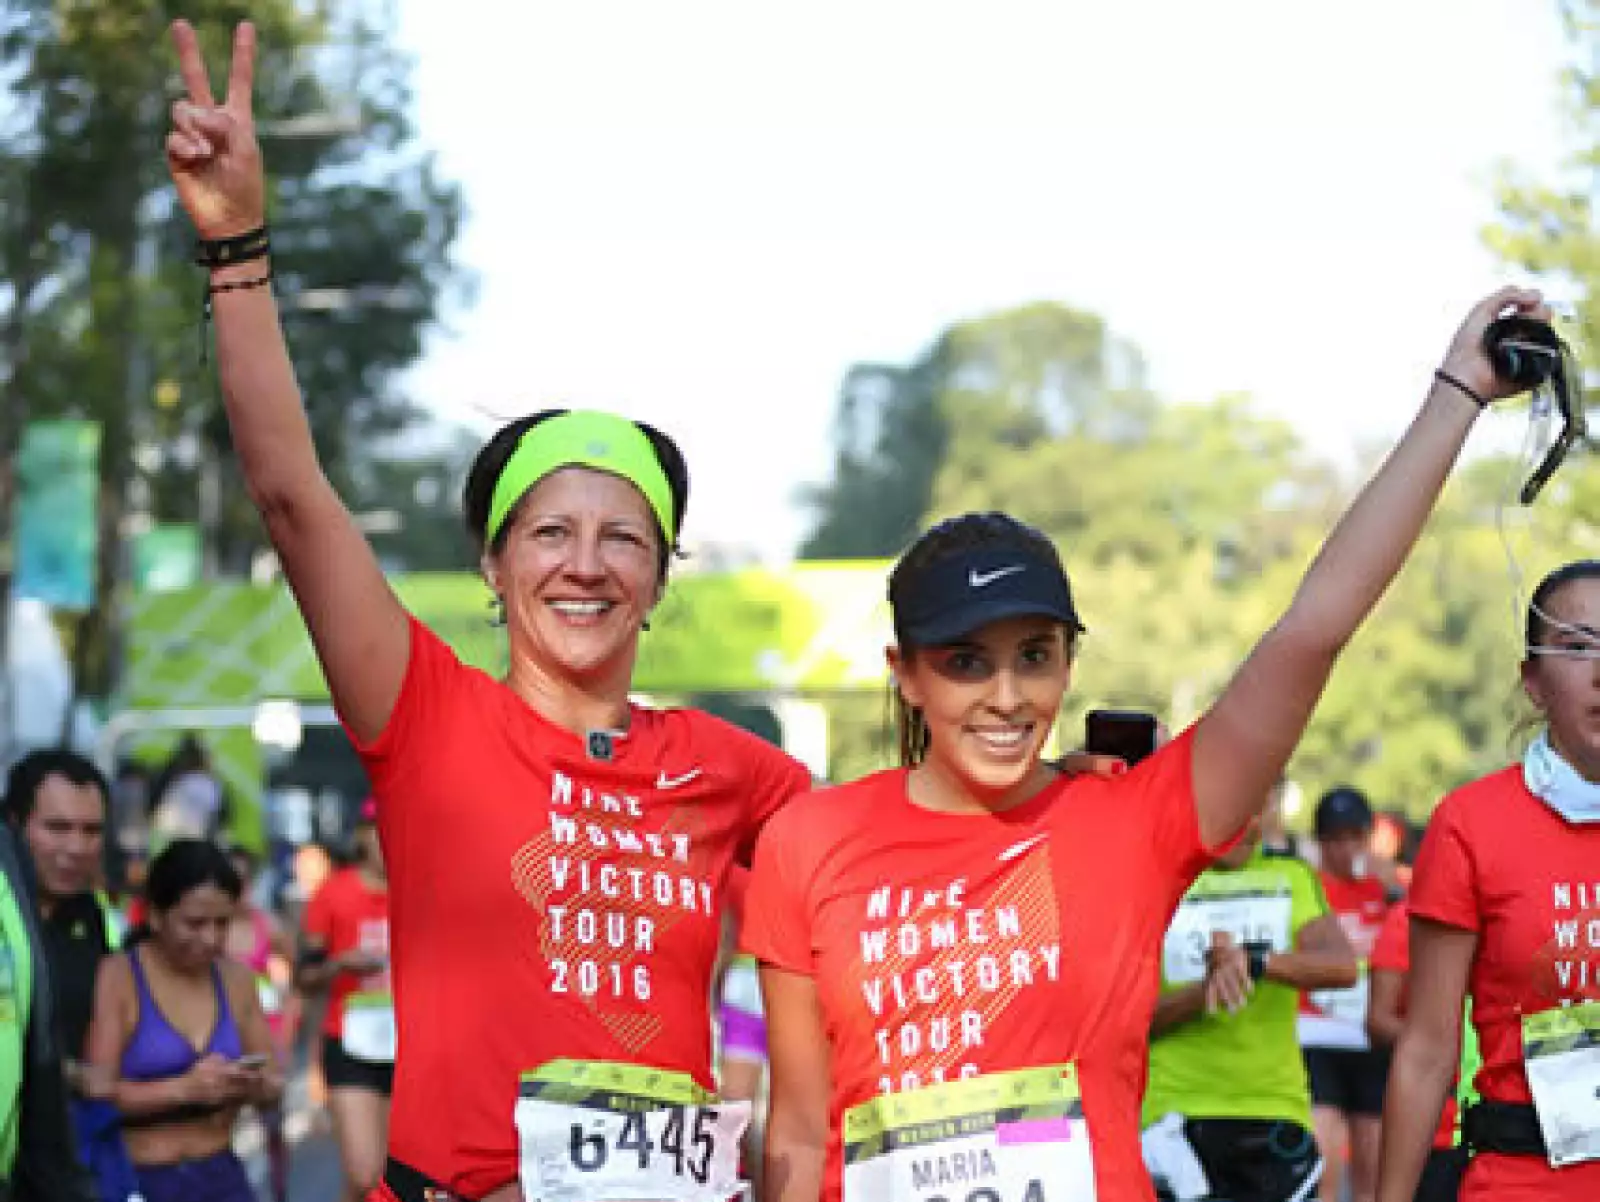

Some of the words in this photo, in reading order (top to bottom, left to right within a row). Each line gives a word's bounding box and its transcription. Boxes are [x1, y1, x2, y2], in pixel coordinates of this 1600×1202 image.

[548, 855, 712, 916] VICTORY
[549, 905, 654, 952] TOUR
[860, 904, 1021, 963] WOMEN
[550, 960, 651, 1000] 2016
[862, 944, 1060, 1015] VICTORY
[875, 1009, 984, 1064] TOUR
[568, 1105, 721, 1184] 6445
[910, 1148, 996, 1190] MARIA
